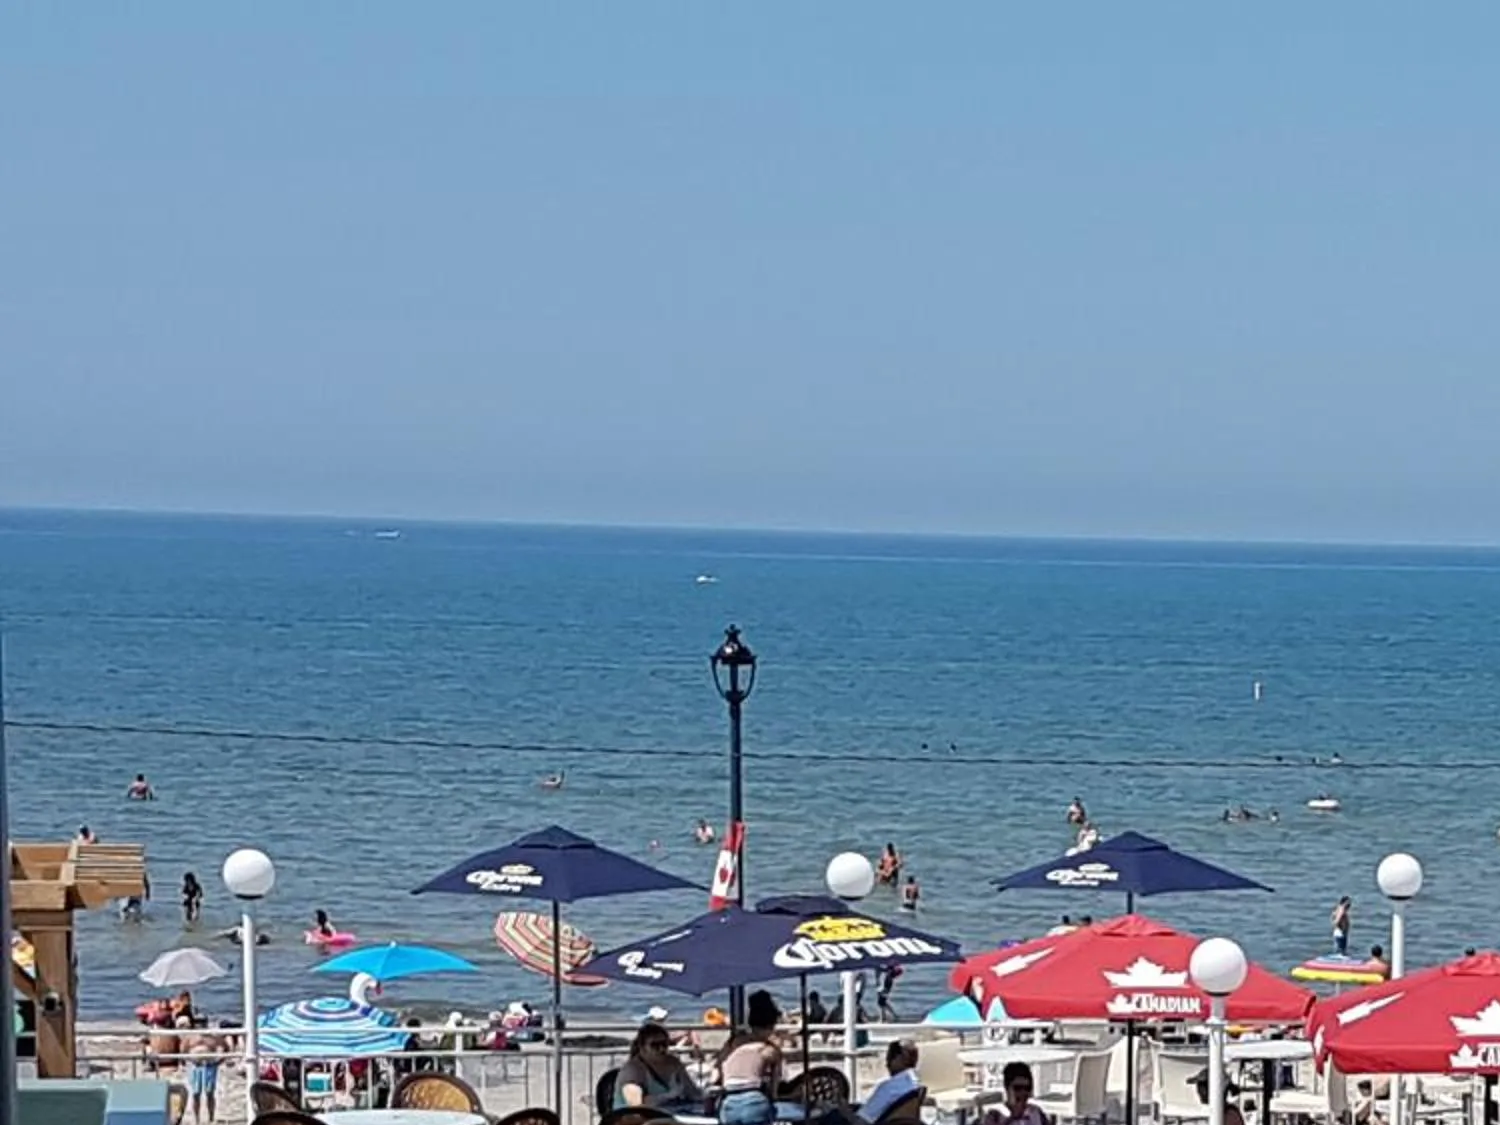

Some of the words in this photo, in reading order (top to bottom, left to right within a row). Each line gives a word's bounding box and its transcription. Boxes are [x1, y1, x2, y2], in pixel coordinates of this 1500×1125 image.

[466, 870, 542, 887] Corona
[1045, 869, 1118, 881] Corona
[773, 938, 942, 969] Corona
[1131, 995, 1201, 1013] CANADIAN
